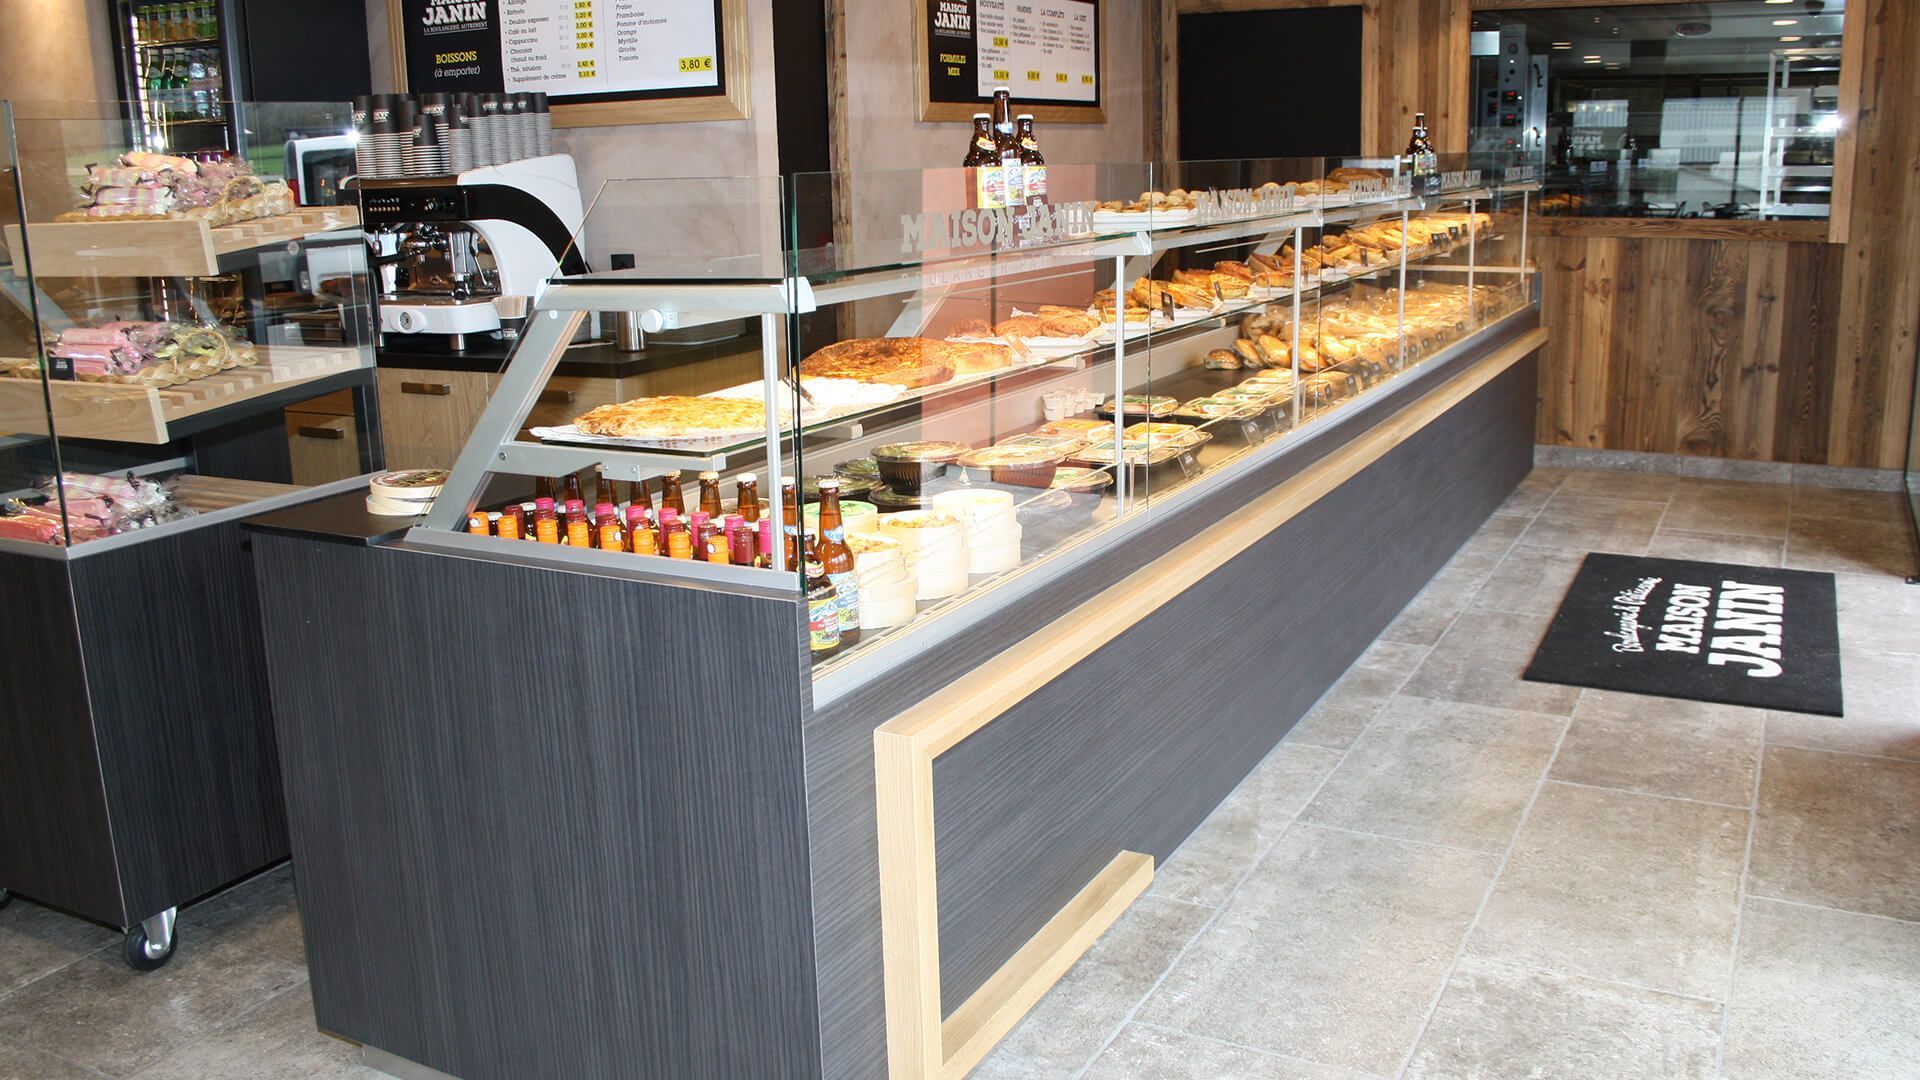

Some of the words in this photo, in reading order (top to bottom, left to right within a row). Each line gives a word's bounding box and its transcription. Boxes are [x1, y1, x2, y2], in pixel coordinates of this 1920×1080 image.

[422, 2, 487, 26] JANIN
[940, 2, 967, 14] MAISON
[935, 12, 970, 30] JANIN
[431, 24, 459, 33] BOULANGERIE
[435, 51, 477, 64] BOISSONS
[510, 47, 532, 55] Chocolat
[680, 59, 700, 71] 3,80
[704, 58, 712, 68] €
[434, 68, 443, 79] (à
[444, 65, 481, 78] emporter)
[512, 74, 542, 83] Supplément
[901, 208, 1016, 253] MAISON
[1020, 201, 1097, 240] JANIN
[1656, 583, 1713, 654] MAISON
[1707, 580, 1785, 678] JANIN
